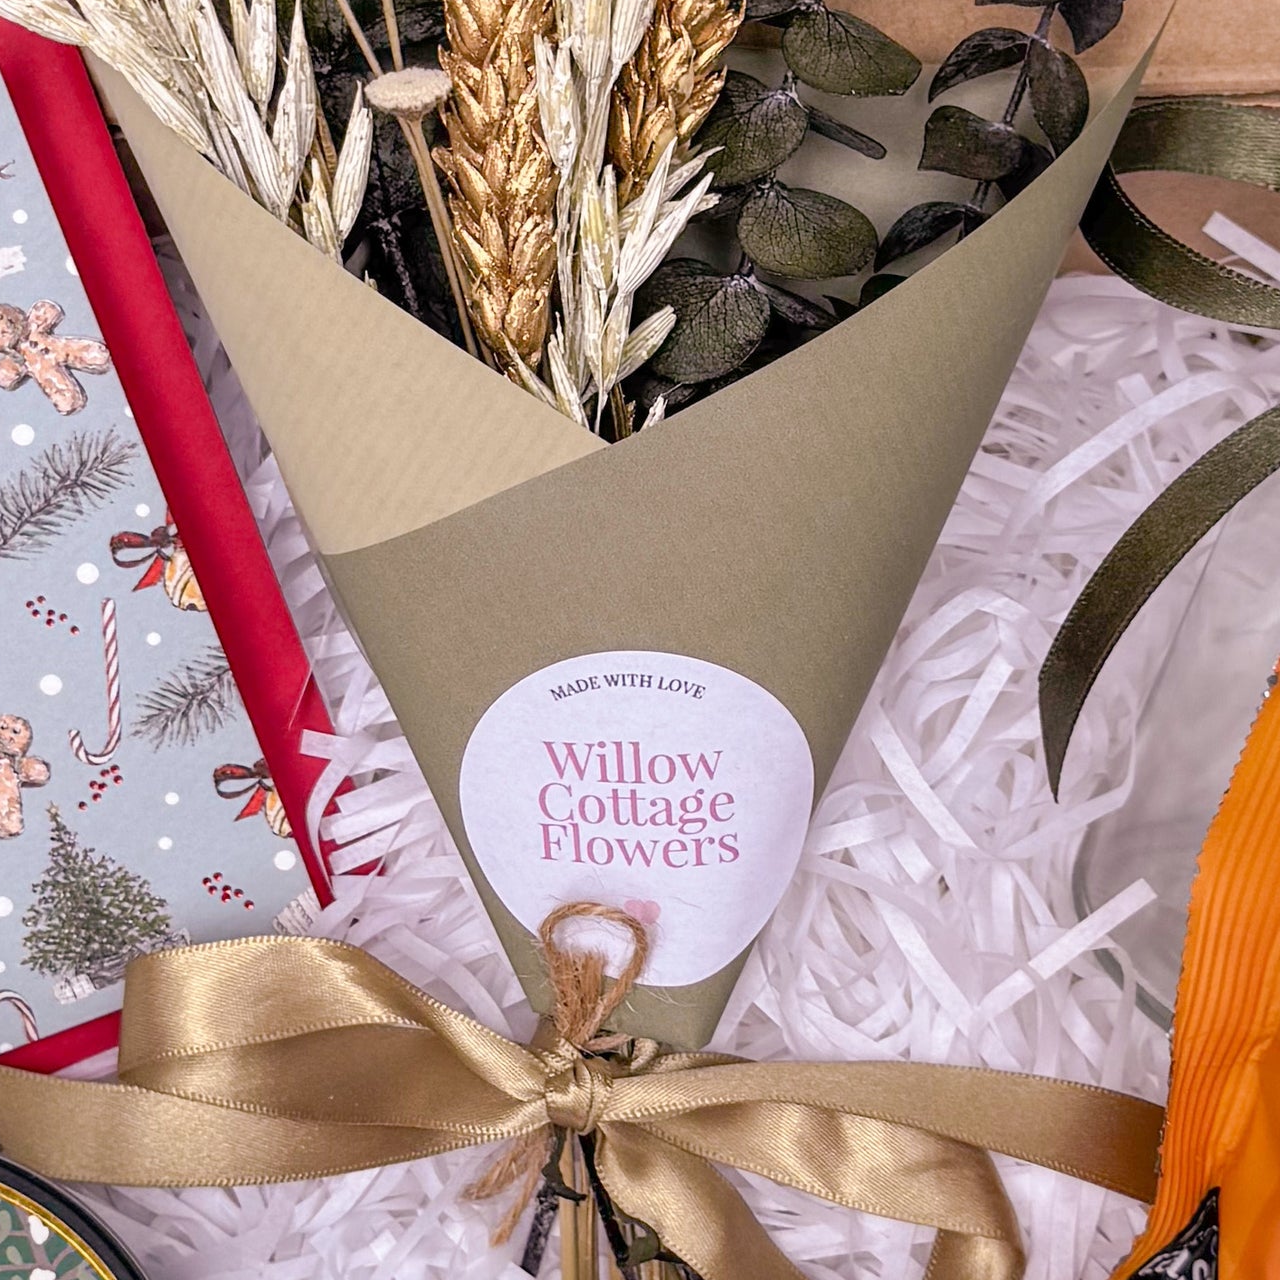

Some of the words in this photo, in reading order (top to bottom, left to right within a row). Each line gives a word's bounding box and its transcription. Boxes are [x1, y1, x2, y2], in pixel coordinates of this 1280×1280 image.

[550, 675, 601, 701] MADE
[604, 673, 653, 689] WITH
[657, 676, 707, 700] LOVE
[542, 740, 724, 785] Willow
[538, 782, 736, 836] Cottage
[538, 822, 740, 868] Flowers
